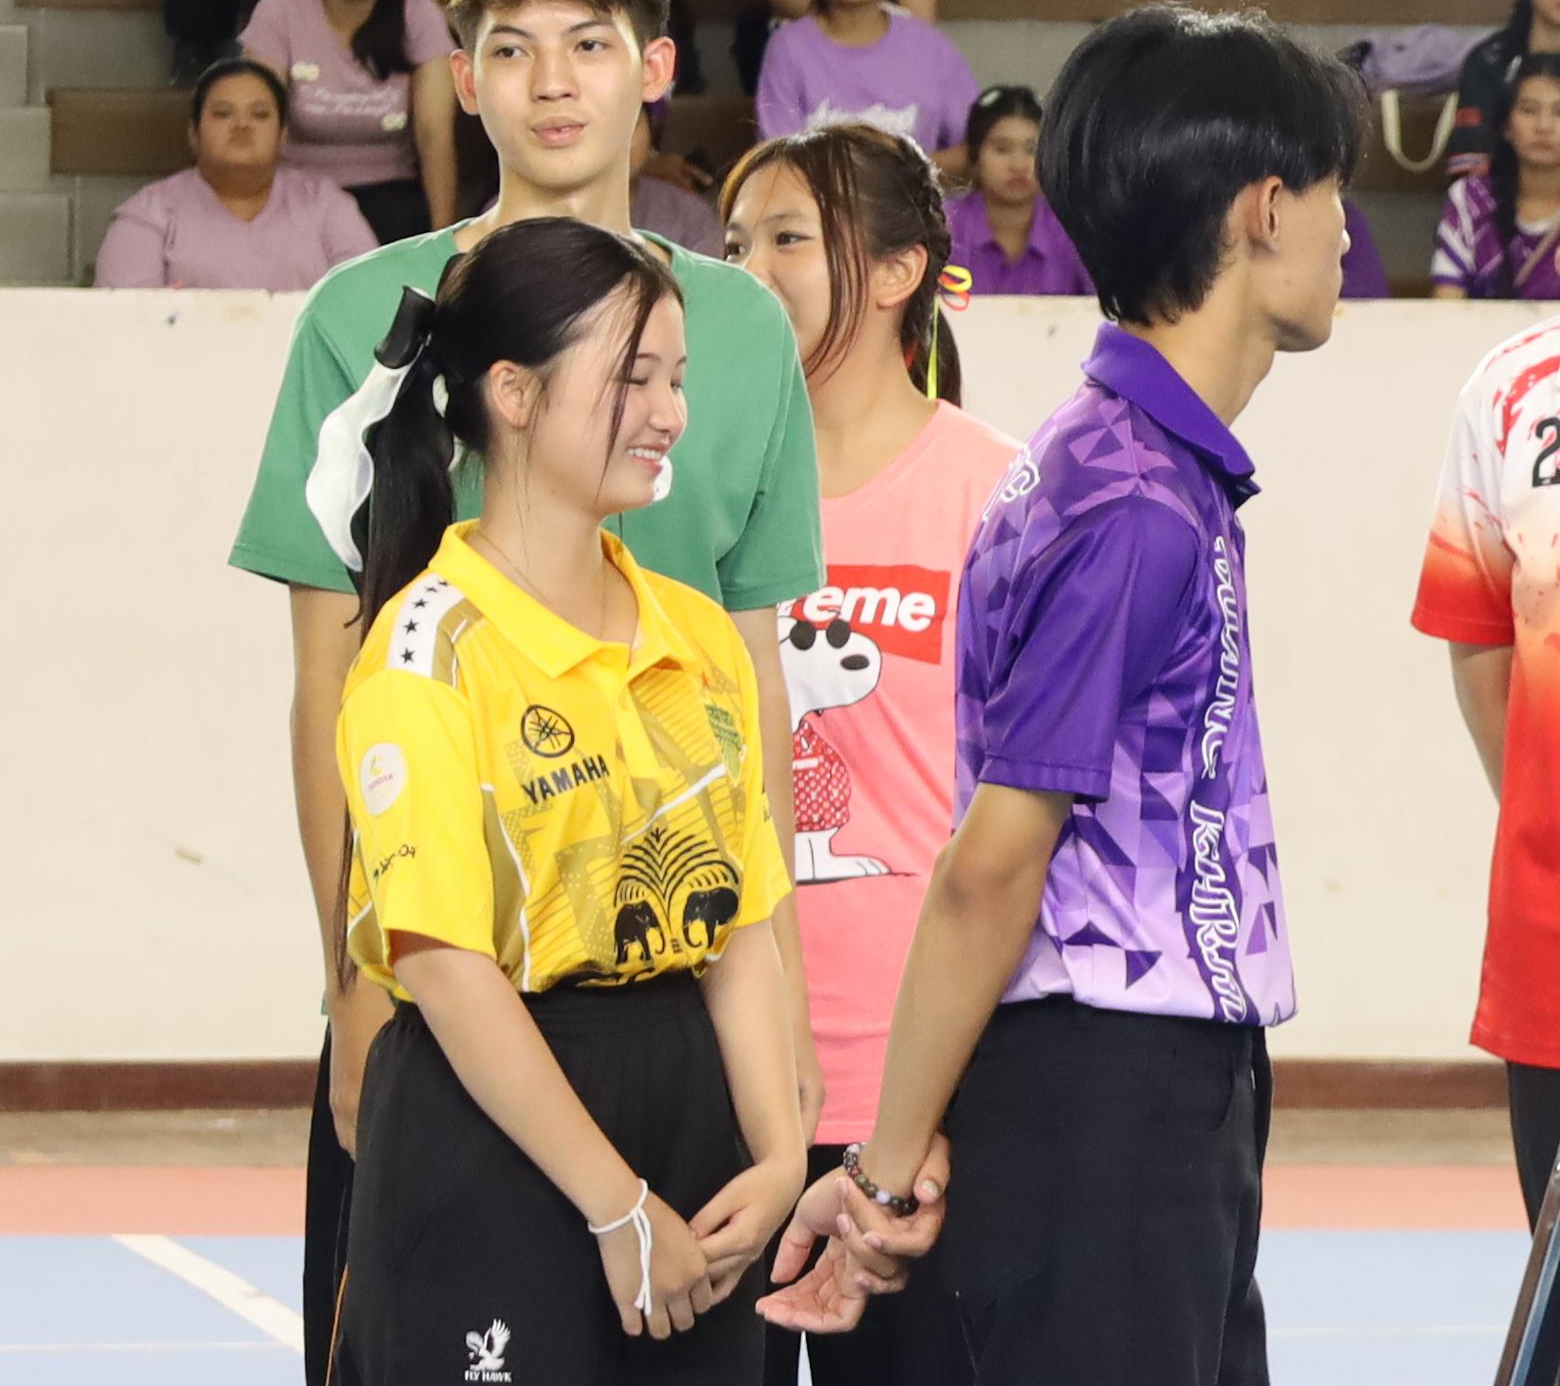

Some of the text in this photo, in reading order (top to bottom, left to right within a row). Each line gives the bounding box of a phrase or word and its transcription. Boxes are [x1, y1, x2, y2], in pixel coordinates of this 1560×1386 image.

[521, 754, 610, 805] YAMAHA
[464, 1369, 512, 1383] FLY HAWK
